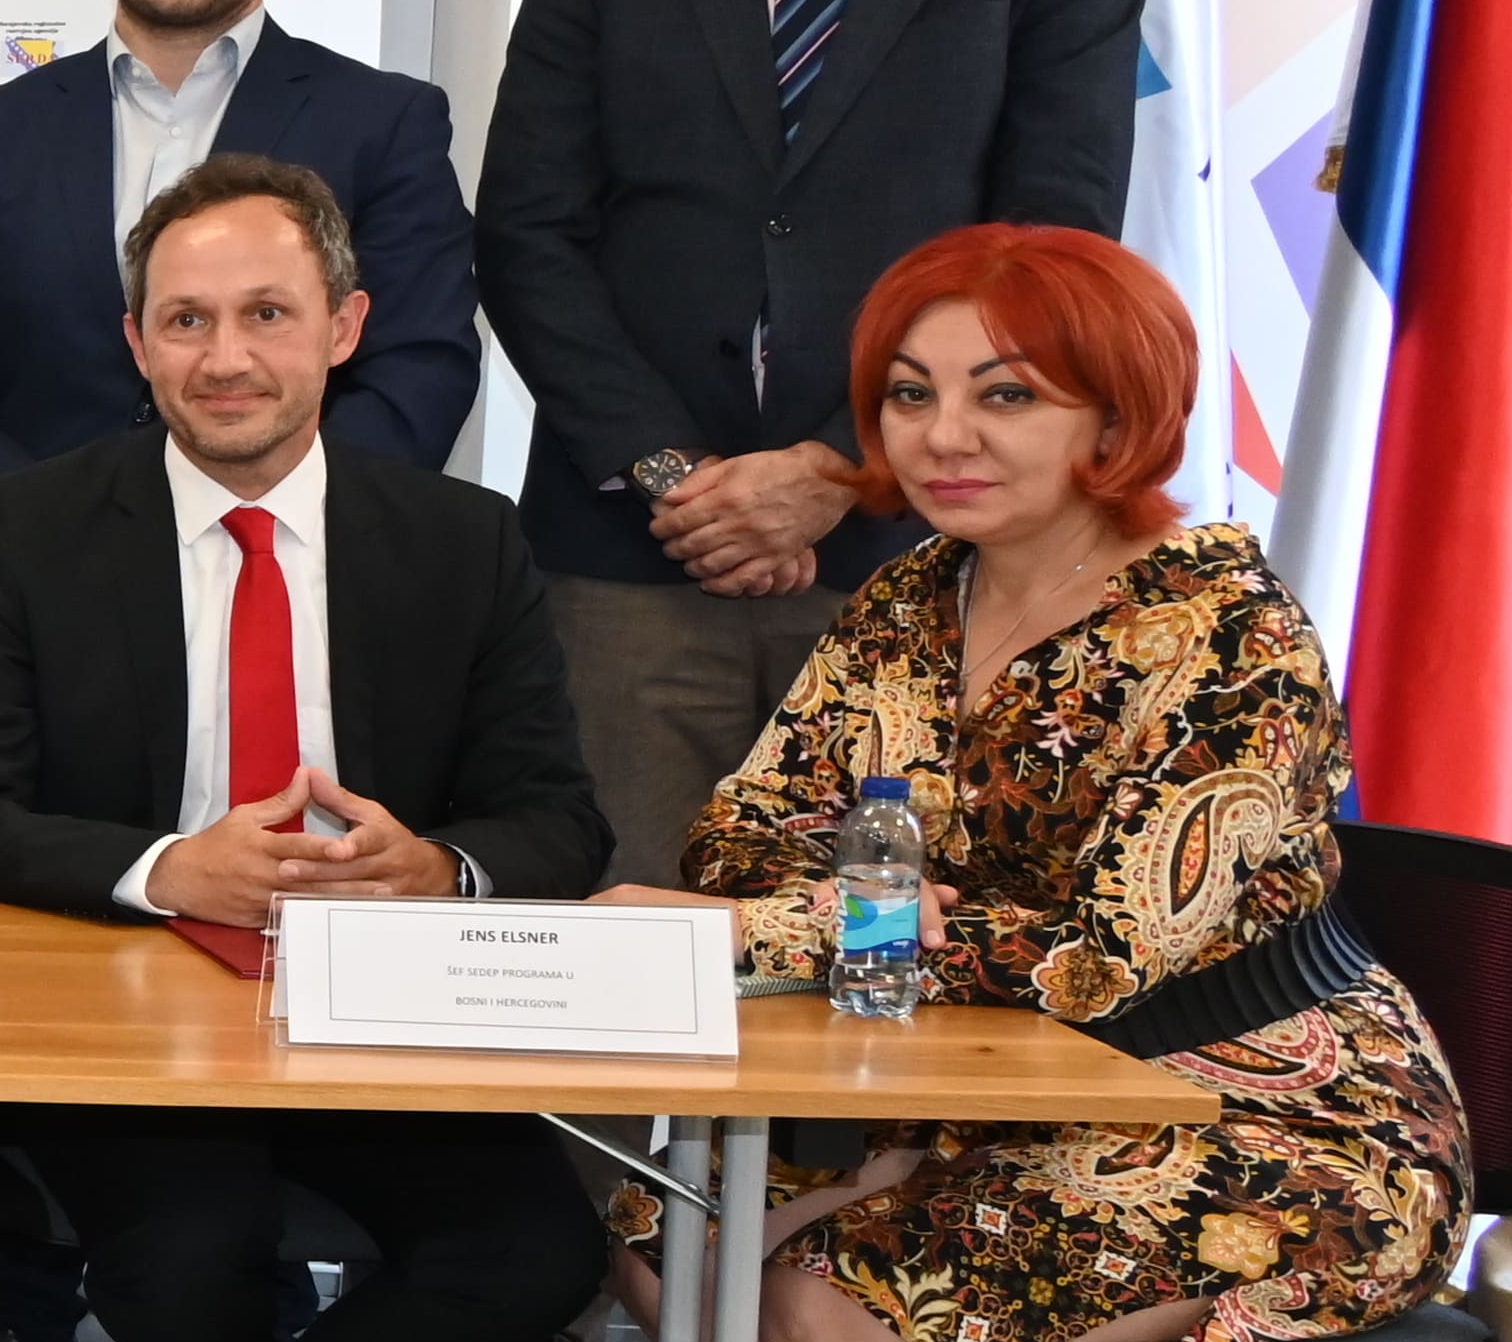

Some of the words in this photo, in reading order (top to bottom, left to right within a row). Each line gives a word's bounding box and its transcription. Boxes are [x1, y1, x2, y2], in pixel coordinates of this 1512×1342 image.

[459, 929, 496, 942] JENS
[501, 930, 559, 945] ELSNER
[502, 969, 564, 979] PROGRAMA
[565, 971, 574, 980] U
[455, 996, 488, 1006] BOSNI
[496, 998, 568, 1009] HERCEGOVINI
